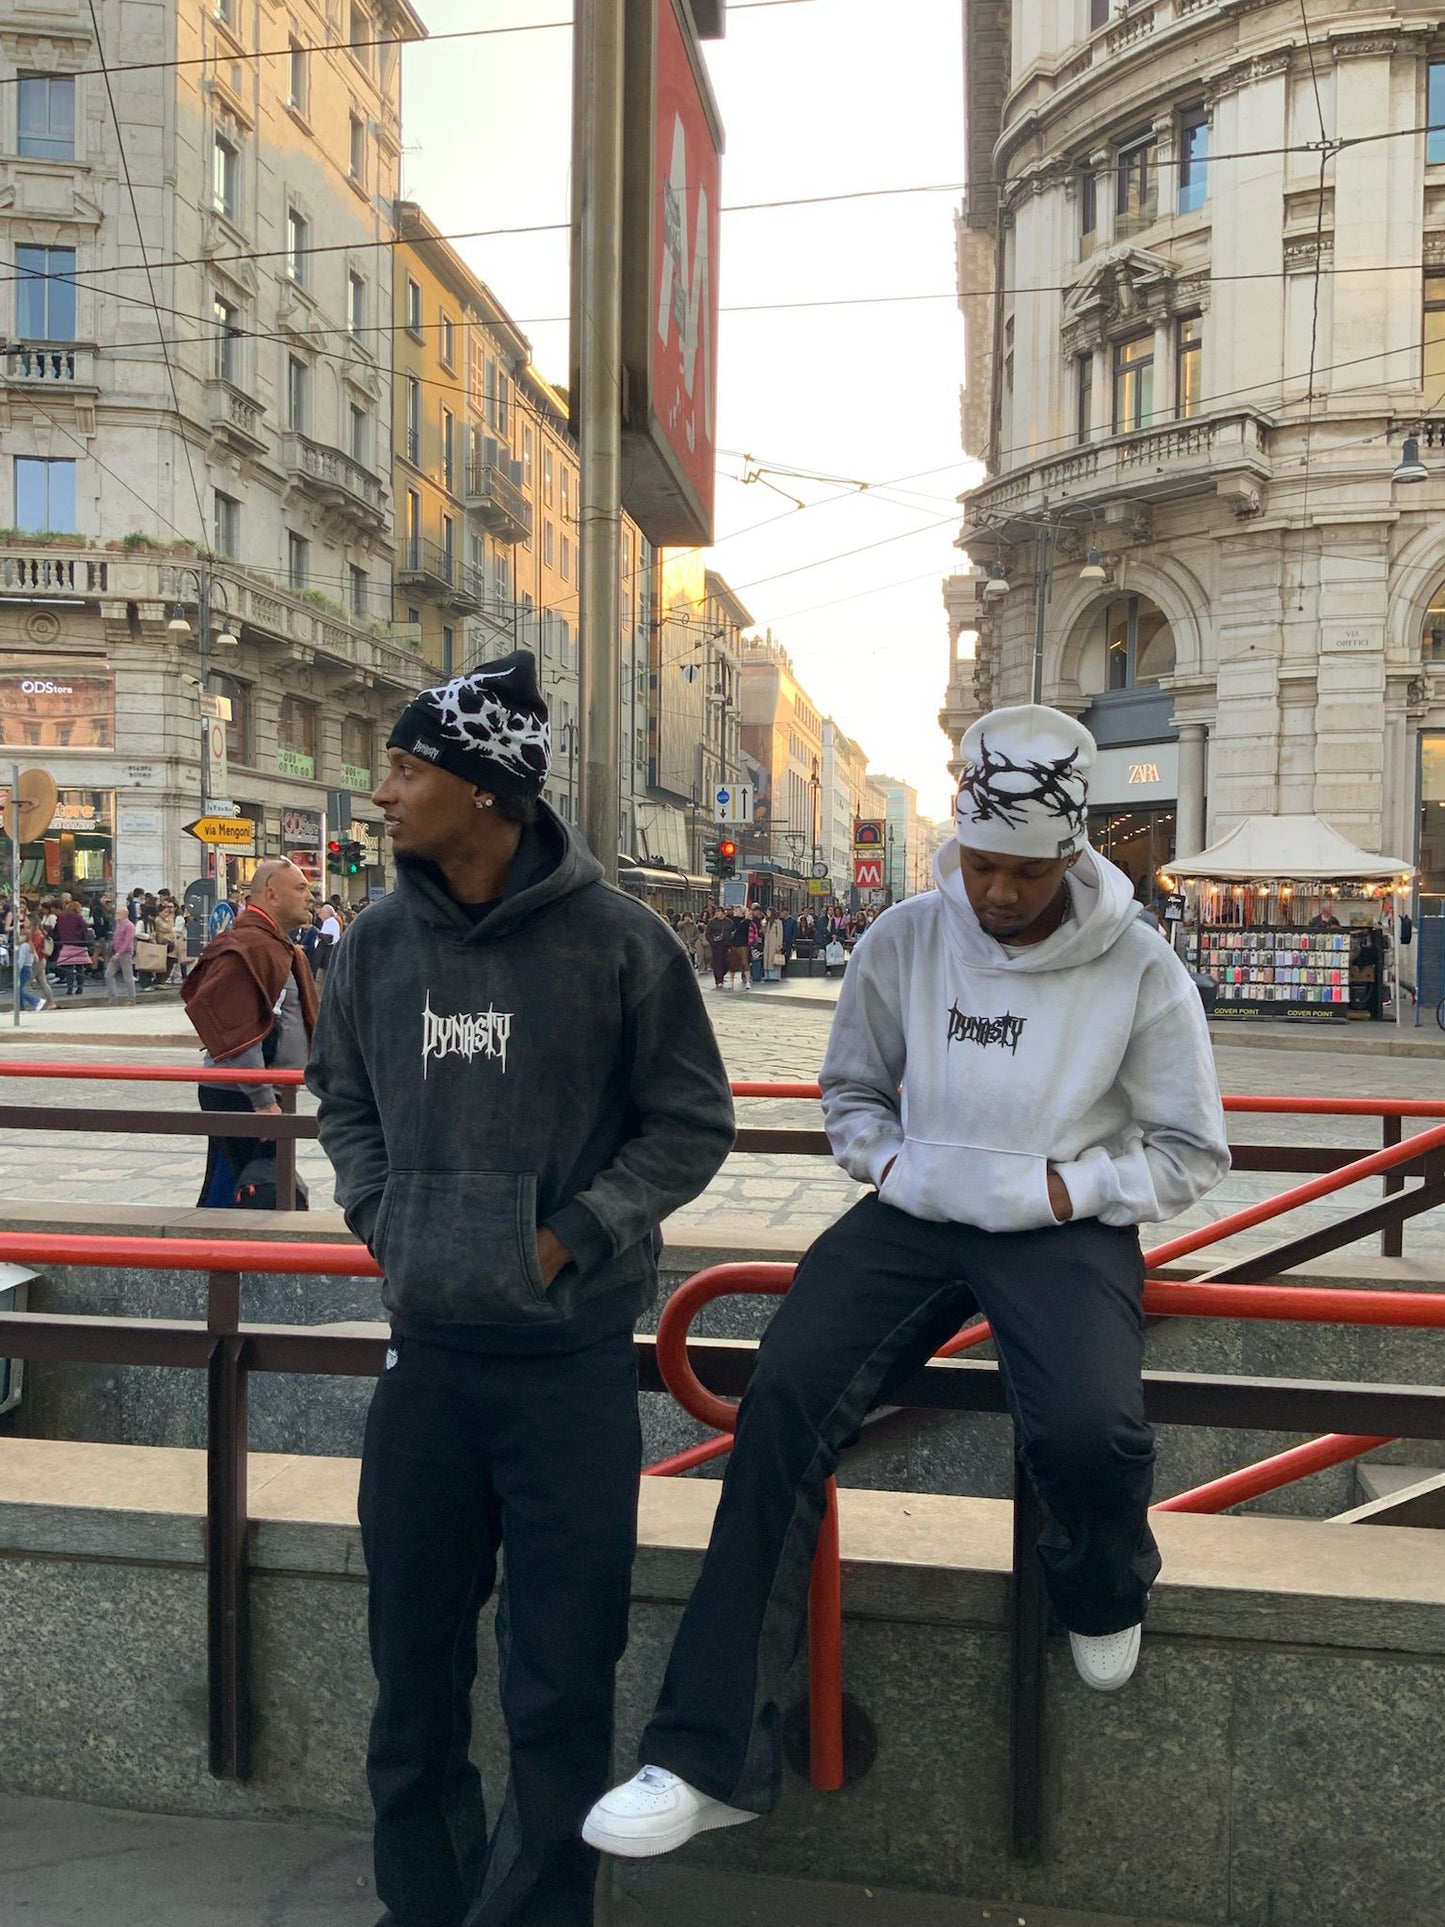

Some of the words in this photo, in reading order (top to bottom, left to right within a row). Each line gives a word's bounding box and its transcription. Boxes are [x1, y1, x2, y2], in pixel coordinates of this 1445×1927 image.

[1128, 763, 1161, 784] ZARA
[204, 824, 216, 836] via
[218, 823, 251, 840] Mengoni
[1213, 1007, 1238, 1015] COVER
[1287, 1009, 1312, 1017] COVER
[1312, 1010, 1335, 1018] POINT
[421, 988, 515, 1081] DYNASTY
[946, 996, 1028, 1056] DYNASTY
